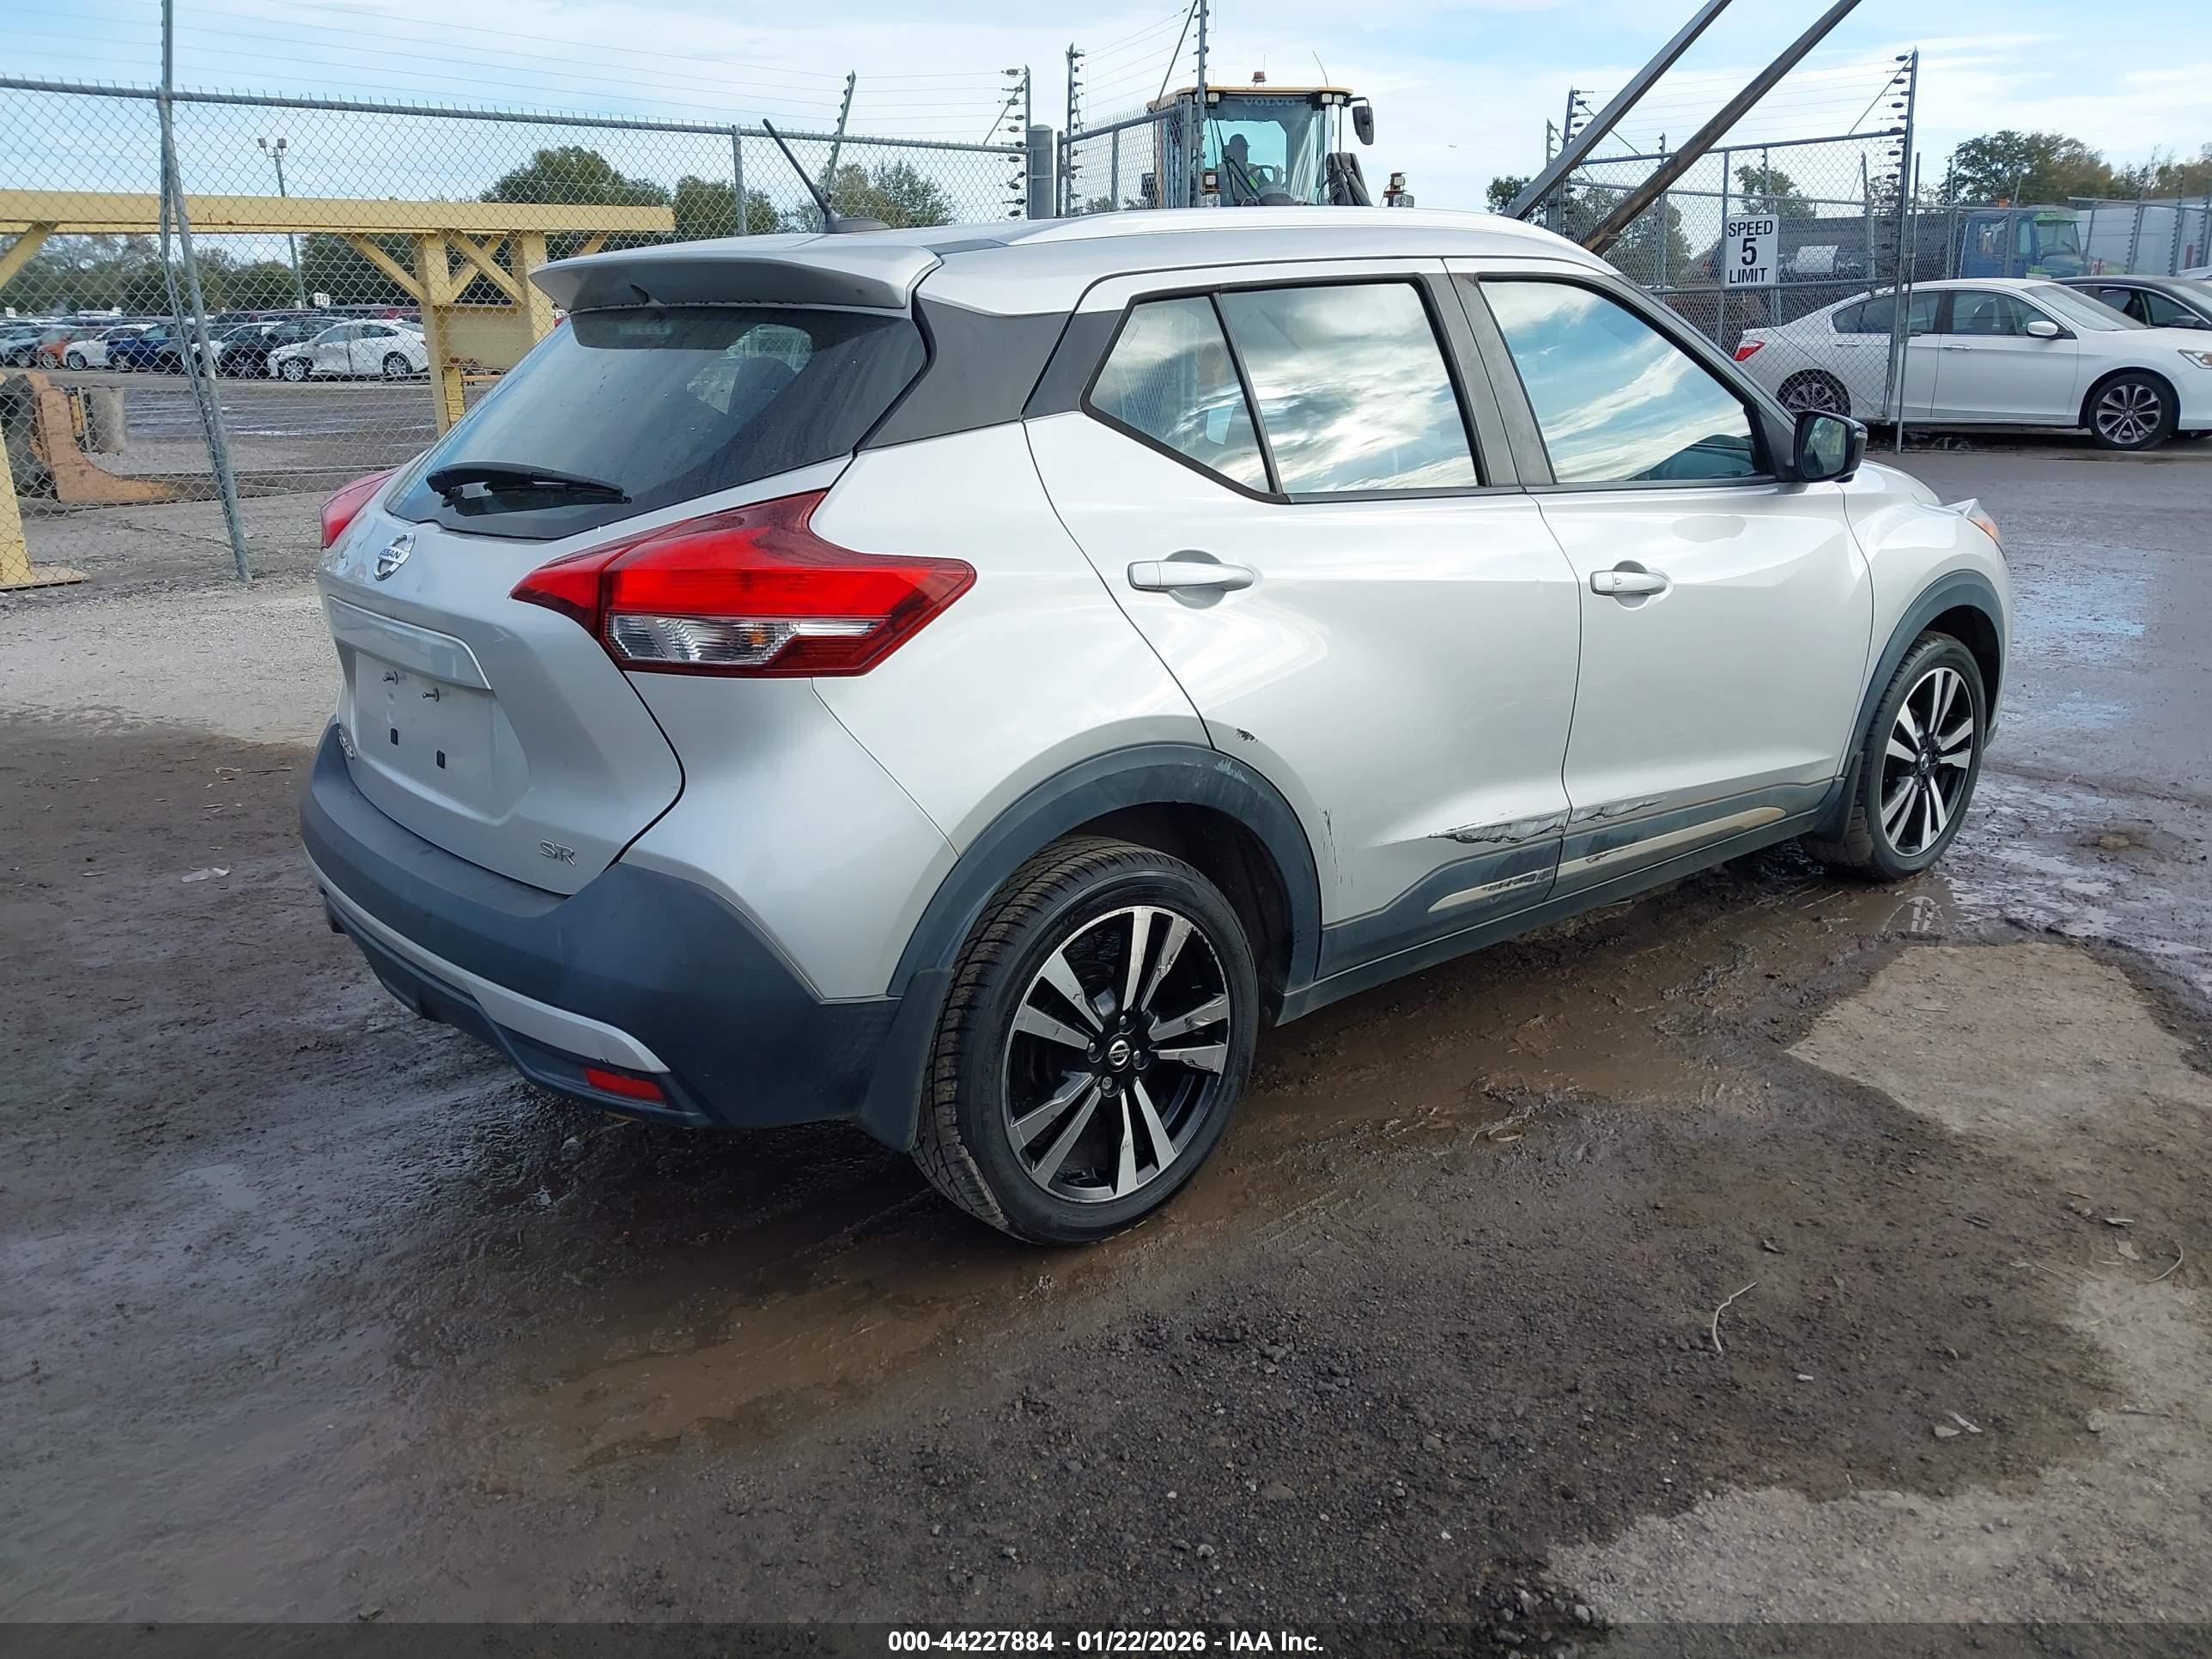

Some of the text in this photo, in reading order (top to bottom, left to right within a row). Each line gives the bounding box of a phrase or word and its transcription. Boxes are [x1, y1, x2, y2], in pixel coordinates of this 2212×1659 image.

[1243, 97, 1296, 106] VOLVO
[1728, 220, 1773, 237] SPEED
[1741, 237, 1757, 265] 5
[1729, 268, 1768, 283] LIMIT
[317, 295, 327, 304] 10
[380, 548, 402, 559] ISSAN
[540, 840, 576, 866] SR
